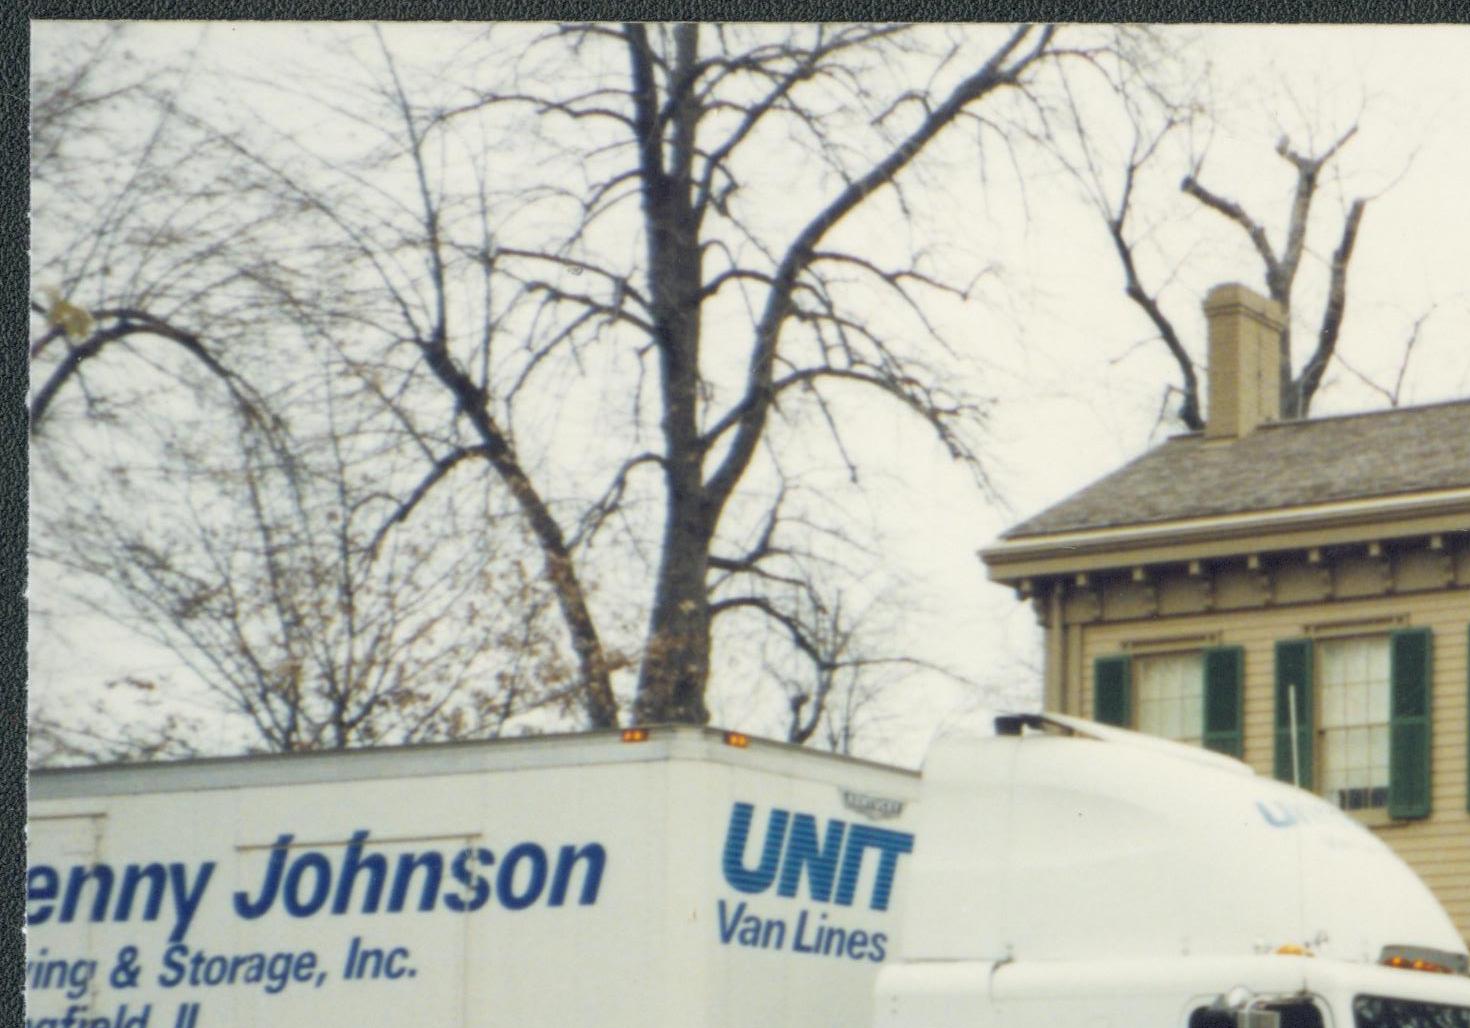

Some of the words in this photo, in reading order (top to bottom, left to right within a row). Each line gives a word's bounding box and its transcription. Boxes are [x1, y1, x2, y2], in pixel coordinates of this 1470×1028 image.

[26, 861, 217, 944] enny
[233, 830, 606, 919] Johnson
[721, 801, 915, 912] UNIT
[26, 948, 97, 1000] ing
[110, 945, 142, 989] &
[158, 943, 329, 994] Storage,
[343, 936, 418, 980] Inc.
[718, 899, 787, 951] Van
[792, 909, 888, 963] Lines
